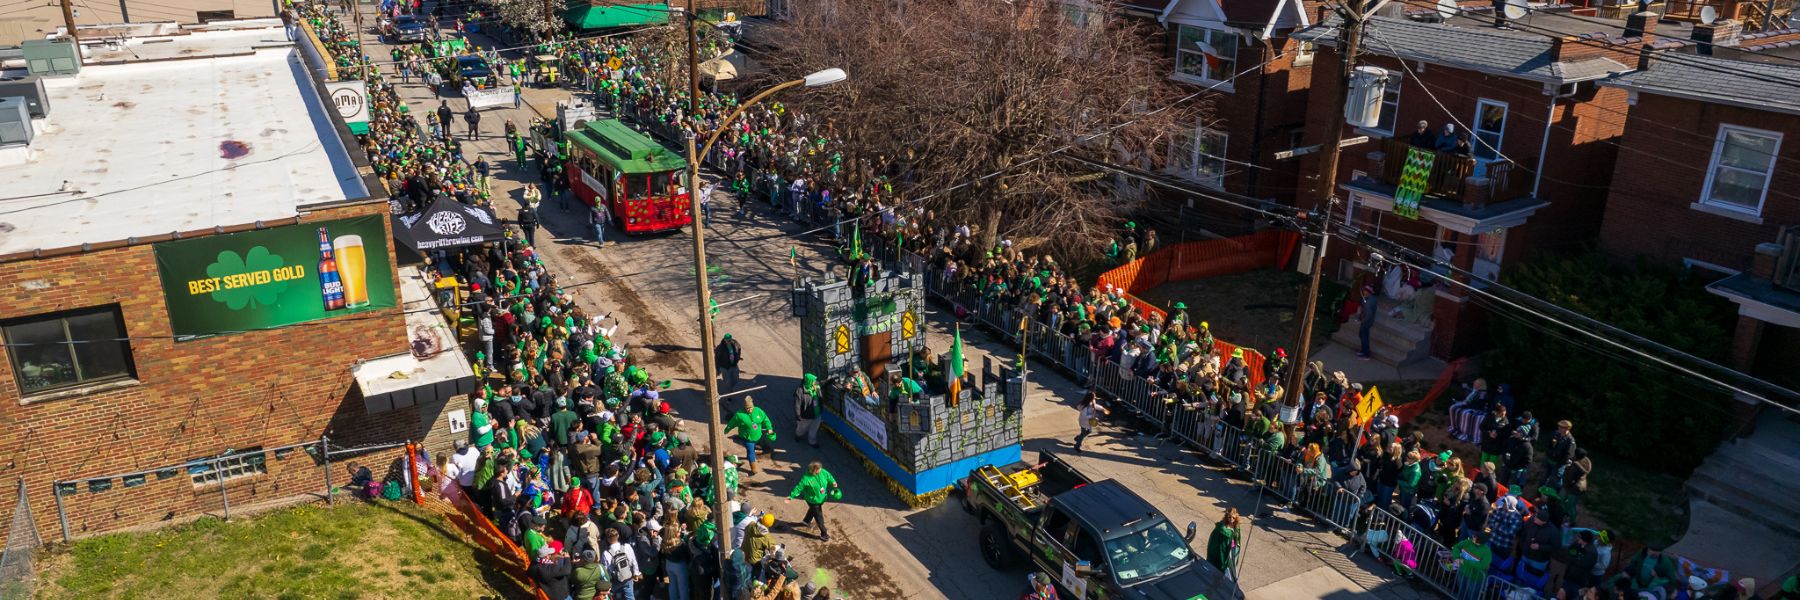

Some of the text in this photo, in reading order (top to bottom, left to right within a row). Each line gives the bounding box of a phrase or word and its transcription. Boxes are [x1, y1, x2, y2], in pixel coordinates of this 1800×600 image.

[335, 95, 364, 106] OMAD
[188, 265, 305, 295] BEST SERVED GOLD
[323, 286, 344, 295] LIGHT
